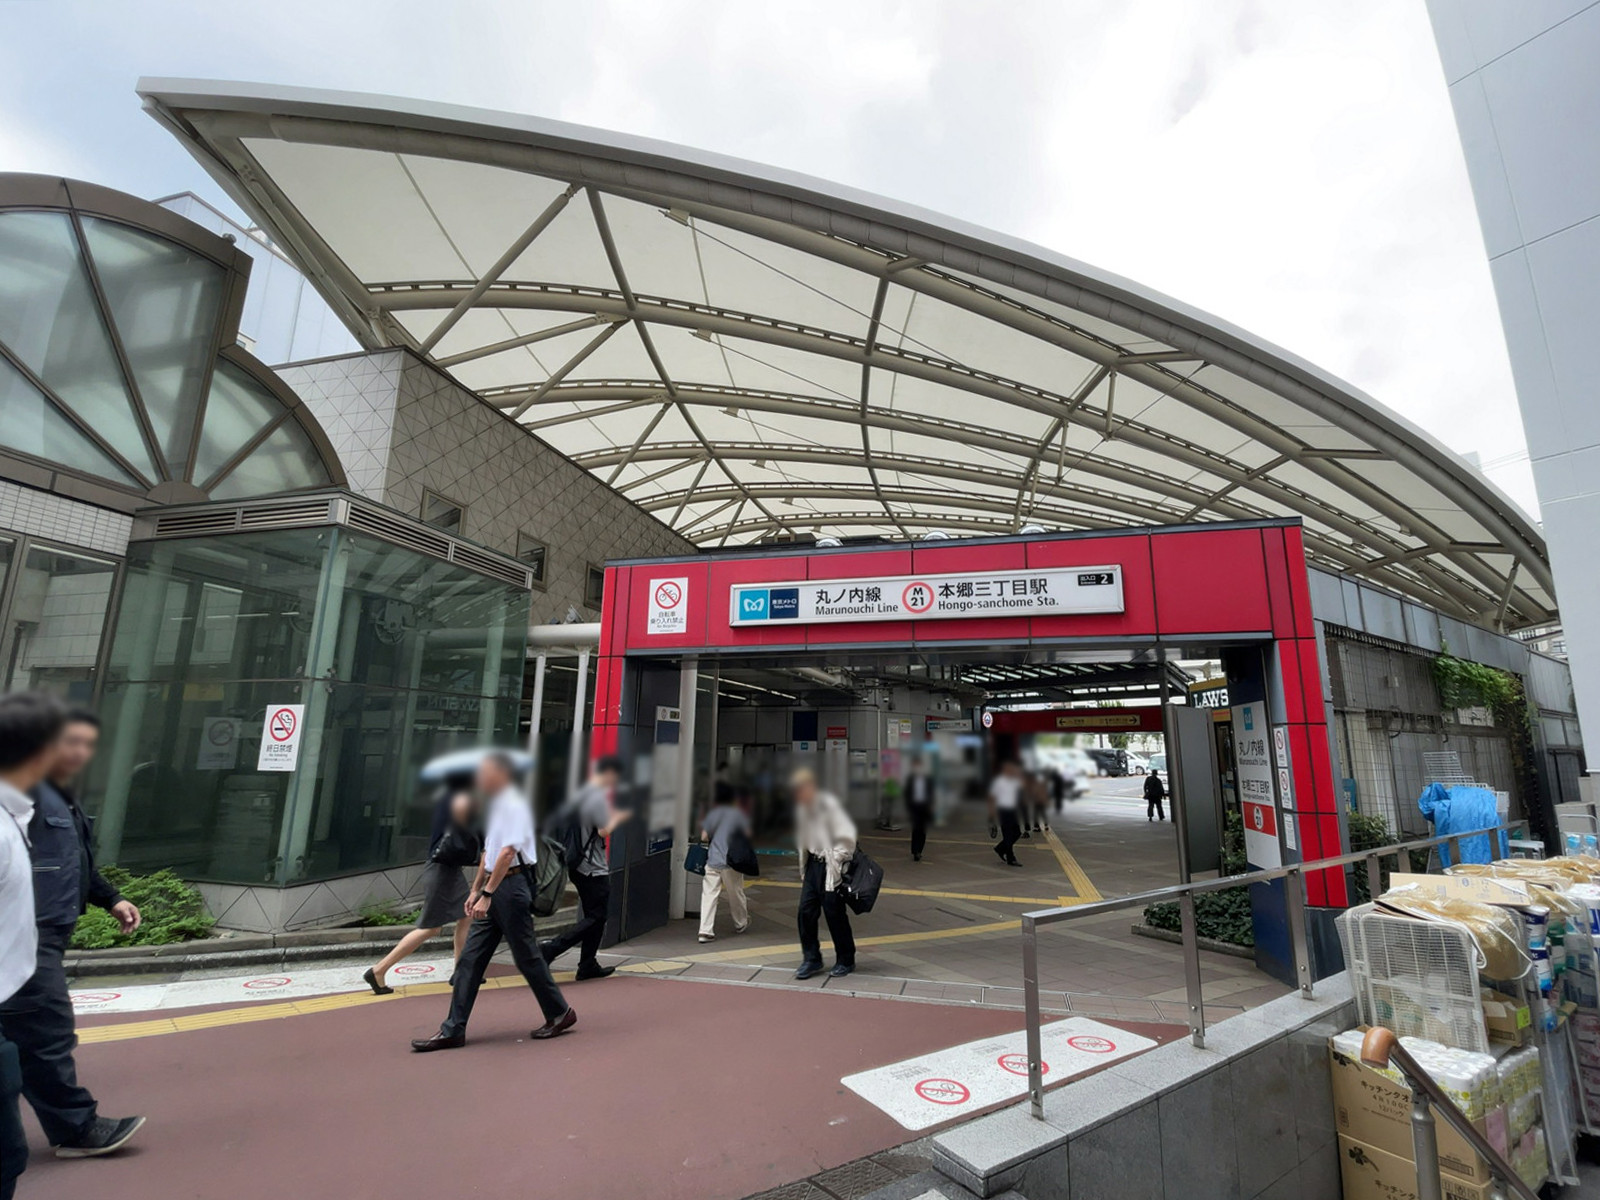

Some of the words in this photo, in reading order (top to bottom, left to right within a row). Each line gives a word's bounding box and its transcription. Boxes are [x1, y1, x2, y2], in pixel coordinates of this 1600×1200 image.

[1100, 574, 1109, 584] 2
[912, 587, 924, 596] M
[938, 578, 1048, 599] 本郷三丁目駅
[815, 587, 882, 605] 丸ノ内線
[911, 597, 925, 607] 21
[815, 604, 874, 616] Marunouchi
[877, 603, 899, 614] Line
[938, 597, 1033, 612] Hongo-sanchome
[1037, 596, 1059, 606] Sta.
[1239, 739, 1265, 757] 丸ノ内線
